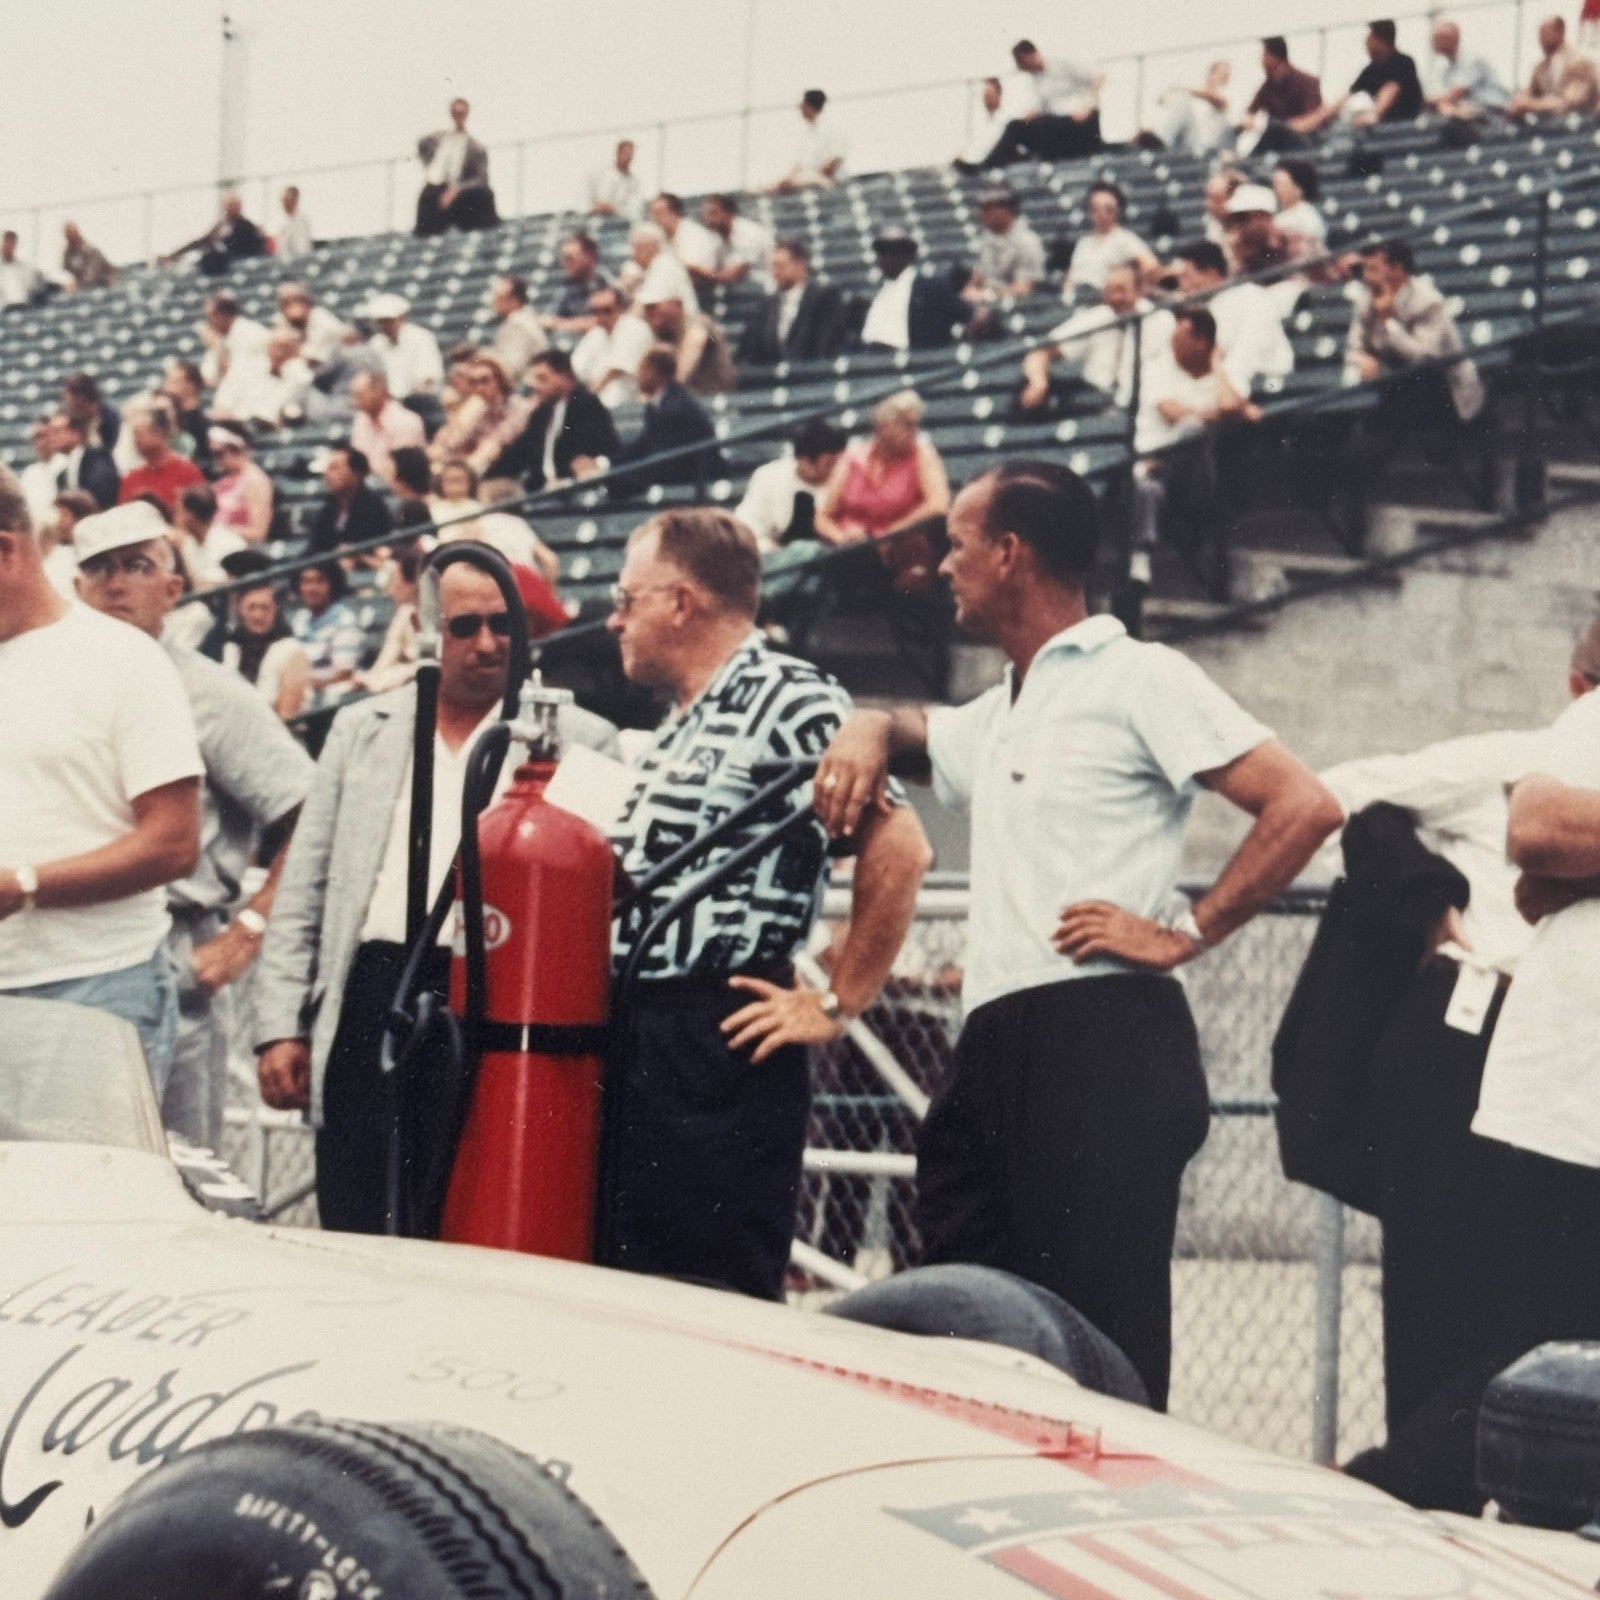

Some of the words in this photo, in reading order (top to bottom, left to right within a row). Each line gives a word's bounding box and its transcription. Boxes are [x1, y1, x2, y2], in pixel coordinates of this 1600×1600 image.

[0, 1266, 252, 1347] LEADER
[407, 1357, 567, 1402] 500
[0, 1343, 319, 1528] Card
